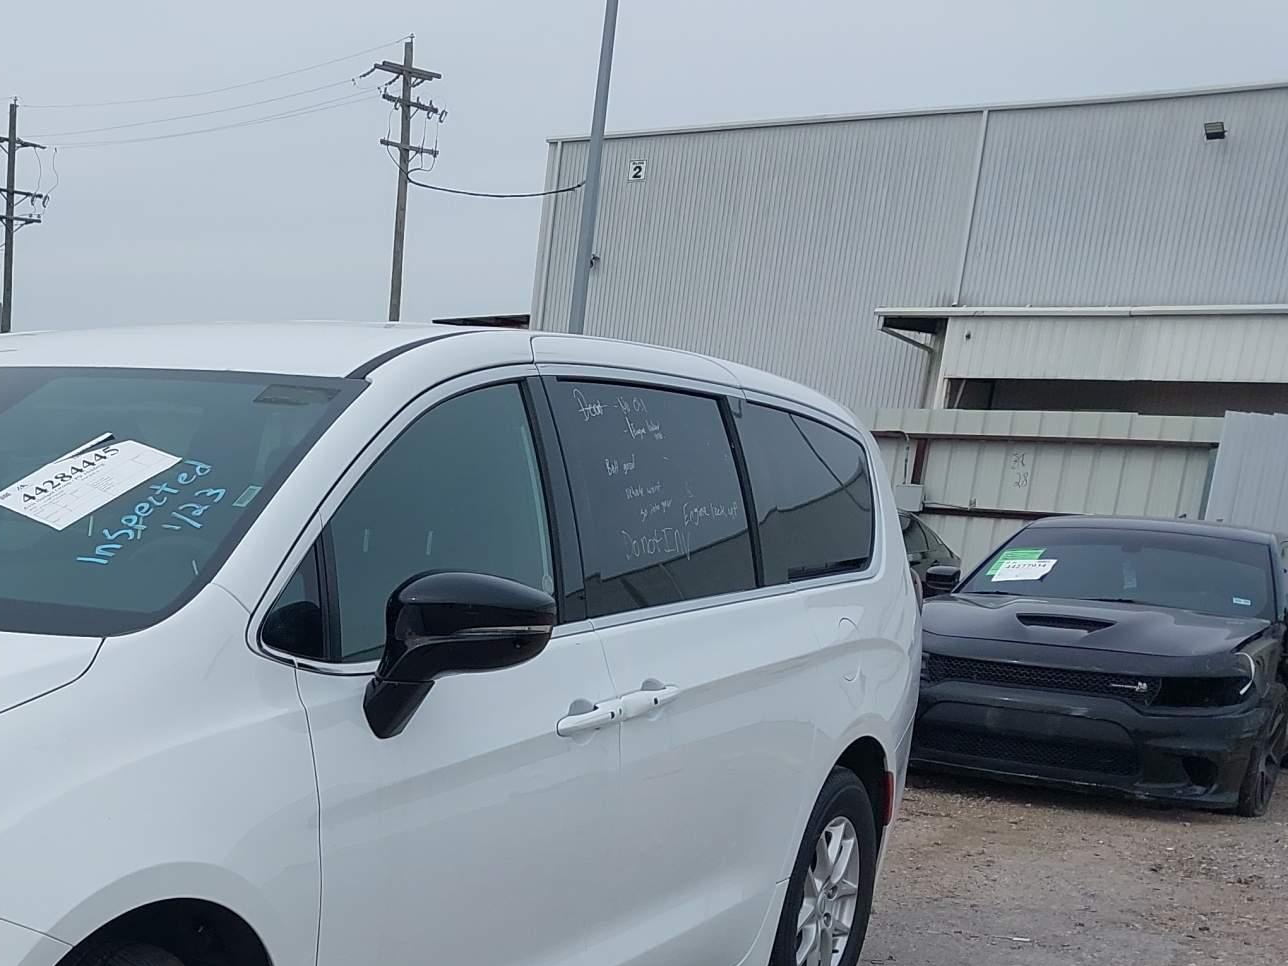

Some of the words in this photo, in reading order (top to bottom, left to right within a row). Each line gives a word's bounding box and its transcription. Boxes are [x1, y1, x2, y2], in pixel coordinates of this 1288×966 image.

[632, 166, 642, 178] 2
[22, 446, 120, 504] 44284445
[76, 460, 212, 564] Inspected
